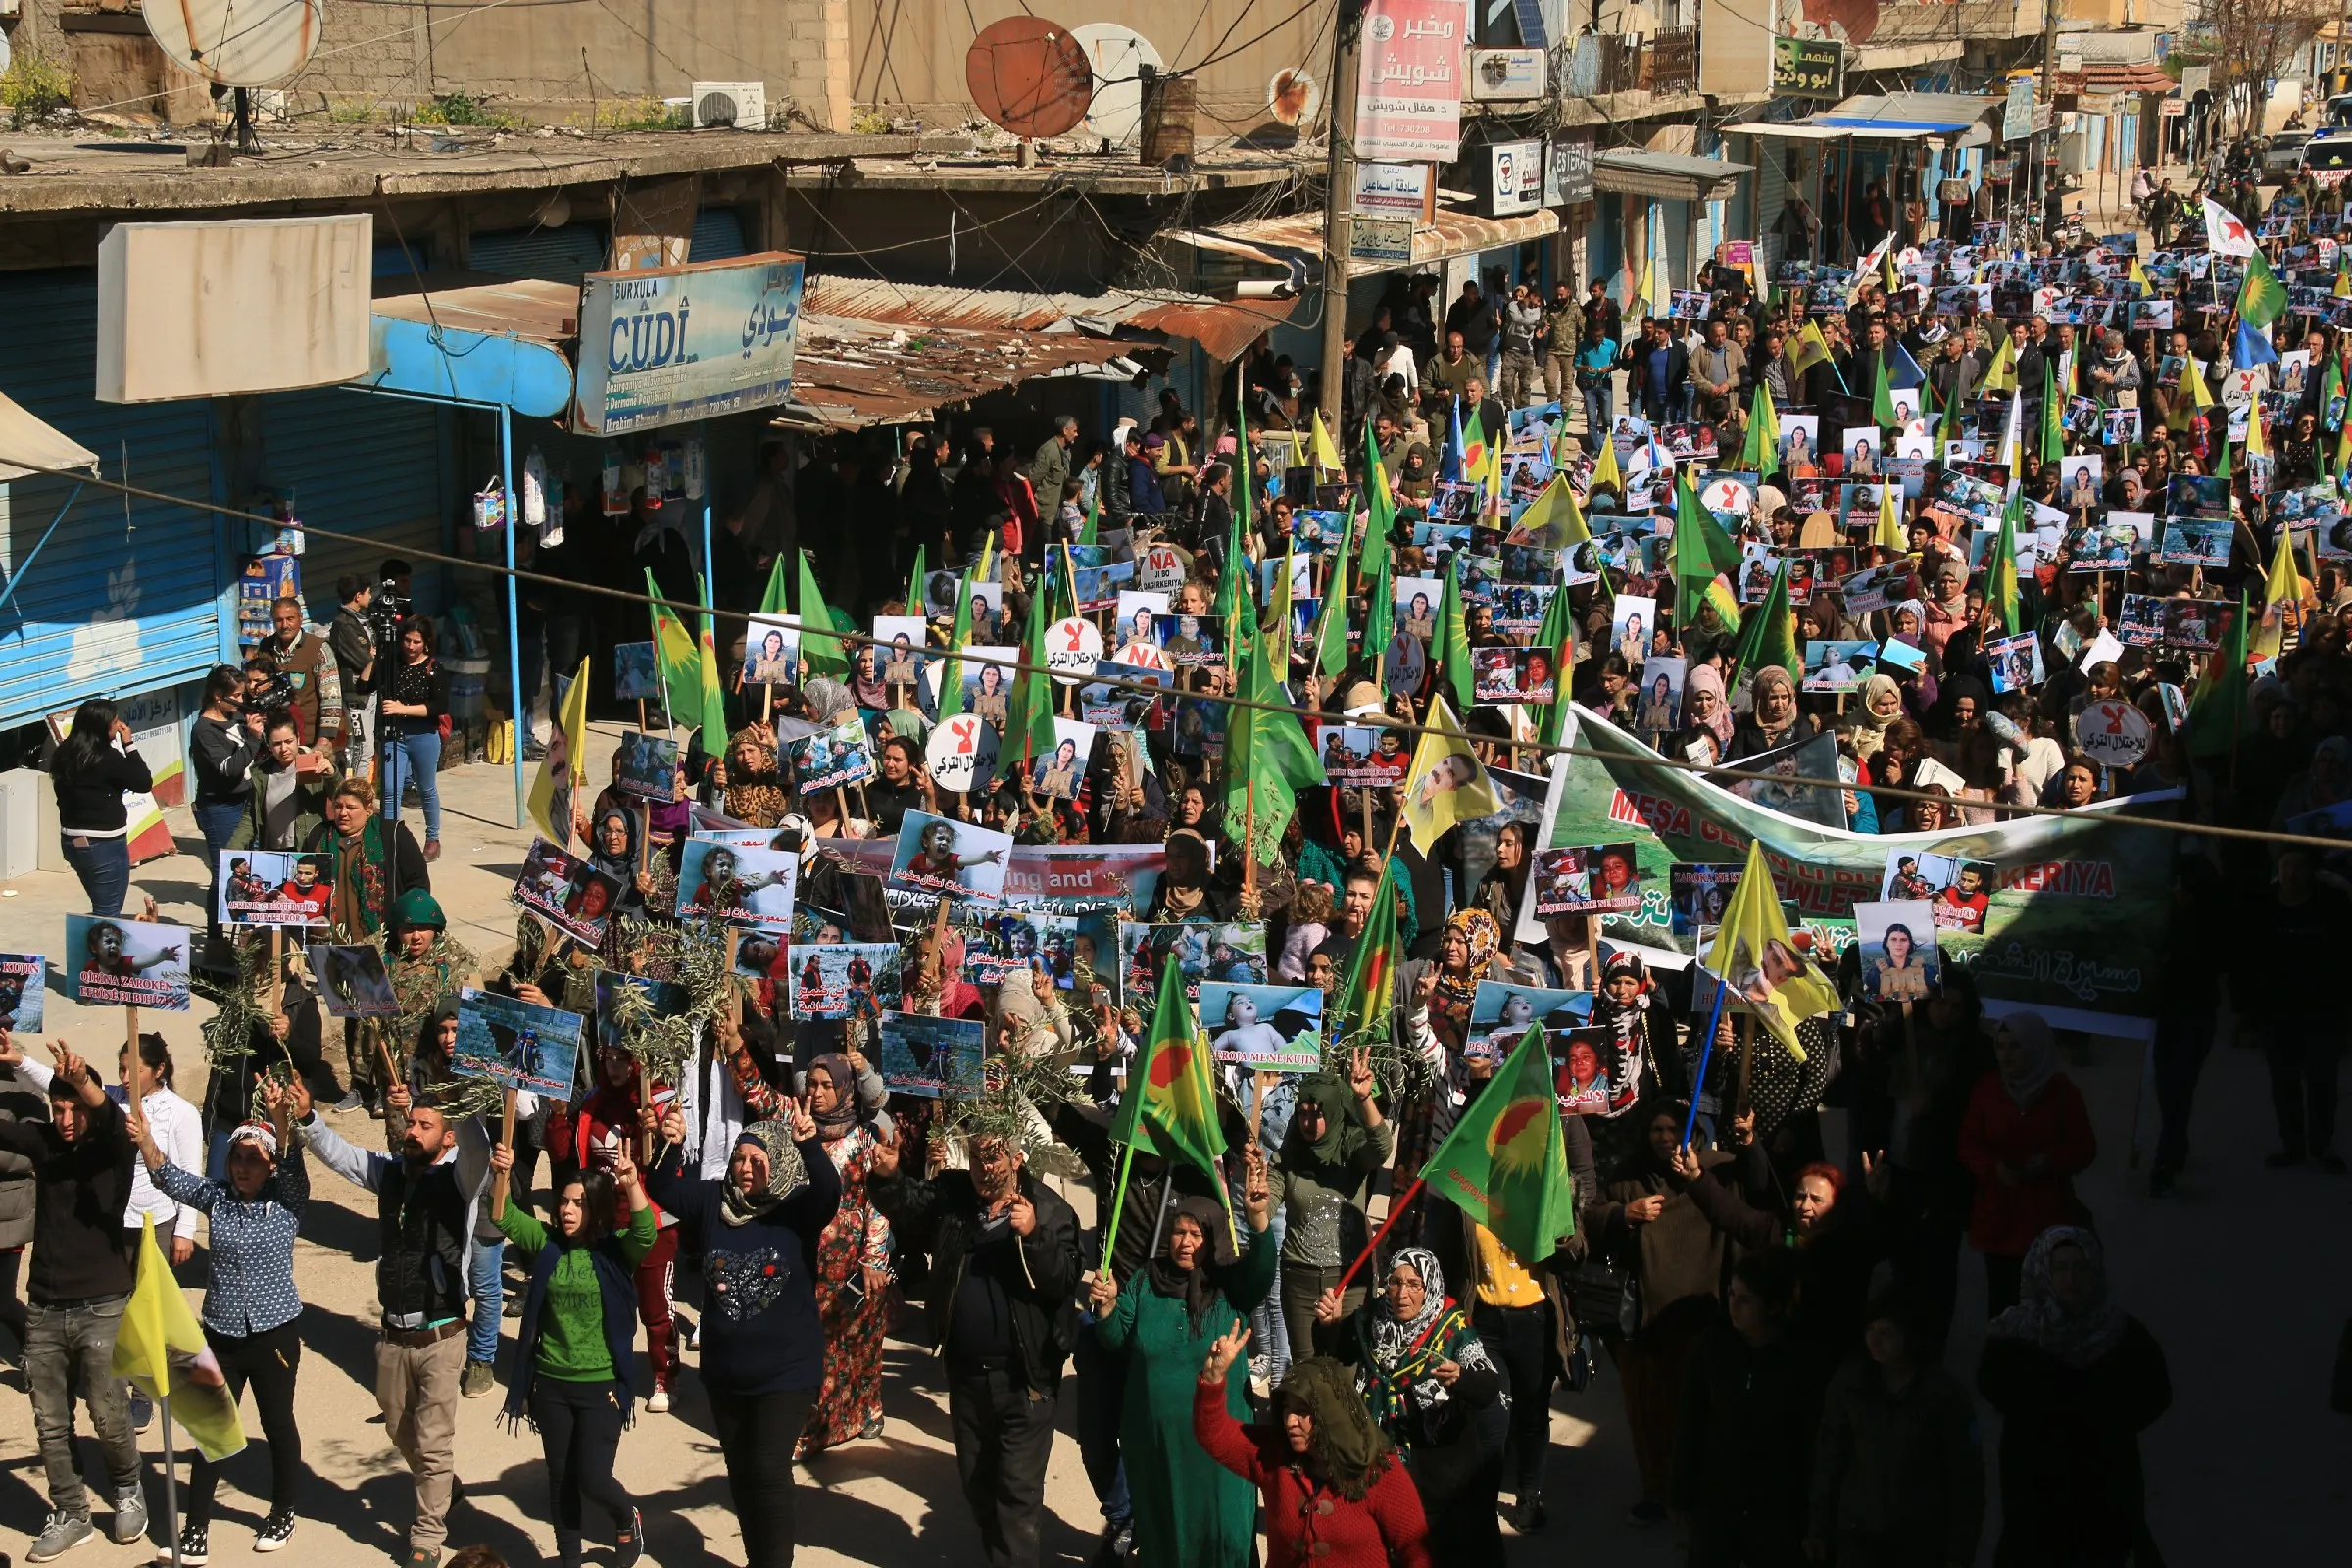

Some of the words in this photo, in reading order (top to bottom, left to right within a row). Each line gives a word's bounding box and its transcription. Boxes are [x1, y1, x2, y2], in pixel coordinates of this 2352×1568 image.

[1402, 14, 1455, 40] مخبر
[1798, 51, 1835, 65] مقهى
[1369, 53, 1451, 86] شويش
[1367, 98, 1406, 113] شويش
[1383, 124, 1398, 133] Tel:
[615, 279, 658, 301] BURXULA
[608, 295, 690, 374] CÛDÎ
[742, 300, 798, 359] جودي
[606, 415, 633, 433] Ibrahim
[1149, 551, 1177, 571] NA
[1064, 621, 1085, 651] لا
[1396, 637, 1411, 666] لا
[1543, 688, 1553, 698] لا
[149, 699, 172, 721] مركز
[2101, 704, 2126, 735] لا
[951, 717, 975, 754] لا
[2083, 733, 2111, 752] التركي
[934, 756, 963, 780] التركي
[1608, 787, 1693, 838] MEŞA
[893, 867, 921, 883] عفرين
[1005, 870, 1042, 890] ing
[1049, 869, 1093, 888] and
[1674, 872, 1715, 883] ZAROKA
[1716, 872, 1730, 883] NE
[944, 881, 975, 895] صرخات
[227, 900, 252, 912] AFRIN
[252, 901, 261, 912] IS
[261, 900, 297, 912] GREATER
[297, 900, 320, 912] THAN
[517, 884, 555, 911] الطفولة
[1537, 902, 1581, 915] PÊŞEROJA
[1582, 900, 1596, 909] ME
[1597, 899, 1611, 909] NE
[1611, 896, 1641, 908] KUJIN
[247, 911, 271, 923] YOUR
[271, 911, 301, 923] TERROR
[564, 910, 595, 933] للحرب
[593, 925, 603, 939] لا
[2, 961, 41, 975] KUJIN
[967, 953, 997, 967] اطفال
[996, 956, 1028, 971] ادعمو
[80, 970, 121, 988] QÎRÎNA
[120, 974, 174, 993] ZAROKÊN
[979, 970, 1006, 984] فرين
[797, 984, 830, 1001] ضمير
[829, 984, 849, 999] اين
[799, 1000, 849, 1013] الانسانية
[1250, 1051, 1267, 1063] ME
[1268, 1053, 1285, 1064] NE
[1285, 1054, 1318, 1066] KUJIN
[1560, 1091, 1594, 1107] للحرب
[1594, 1089, 1607, 1102] لا
